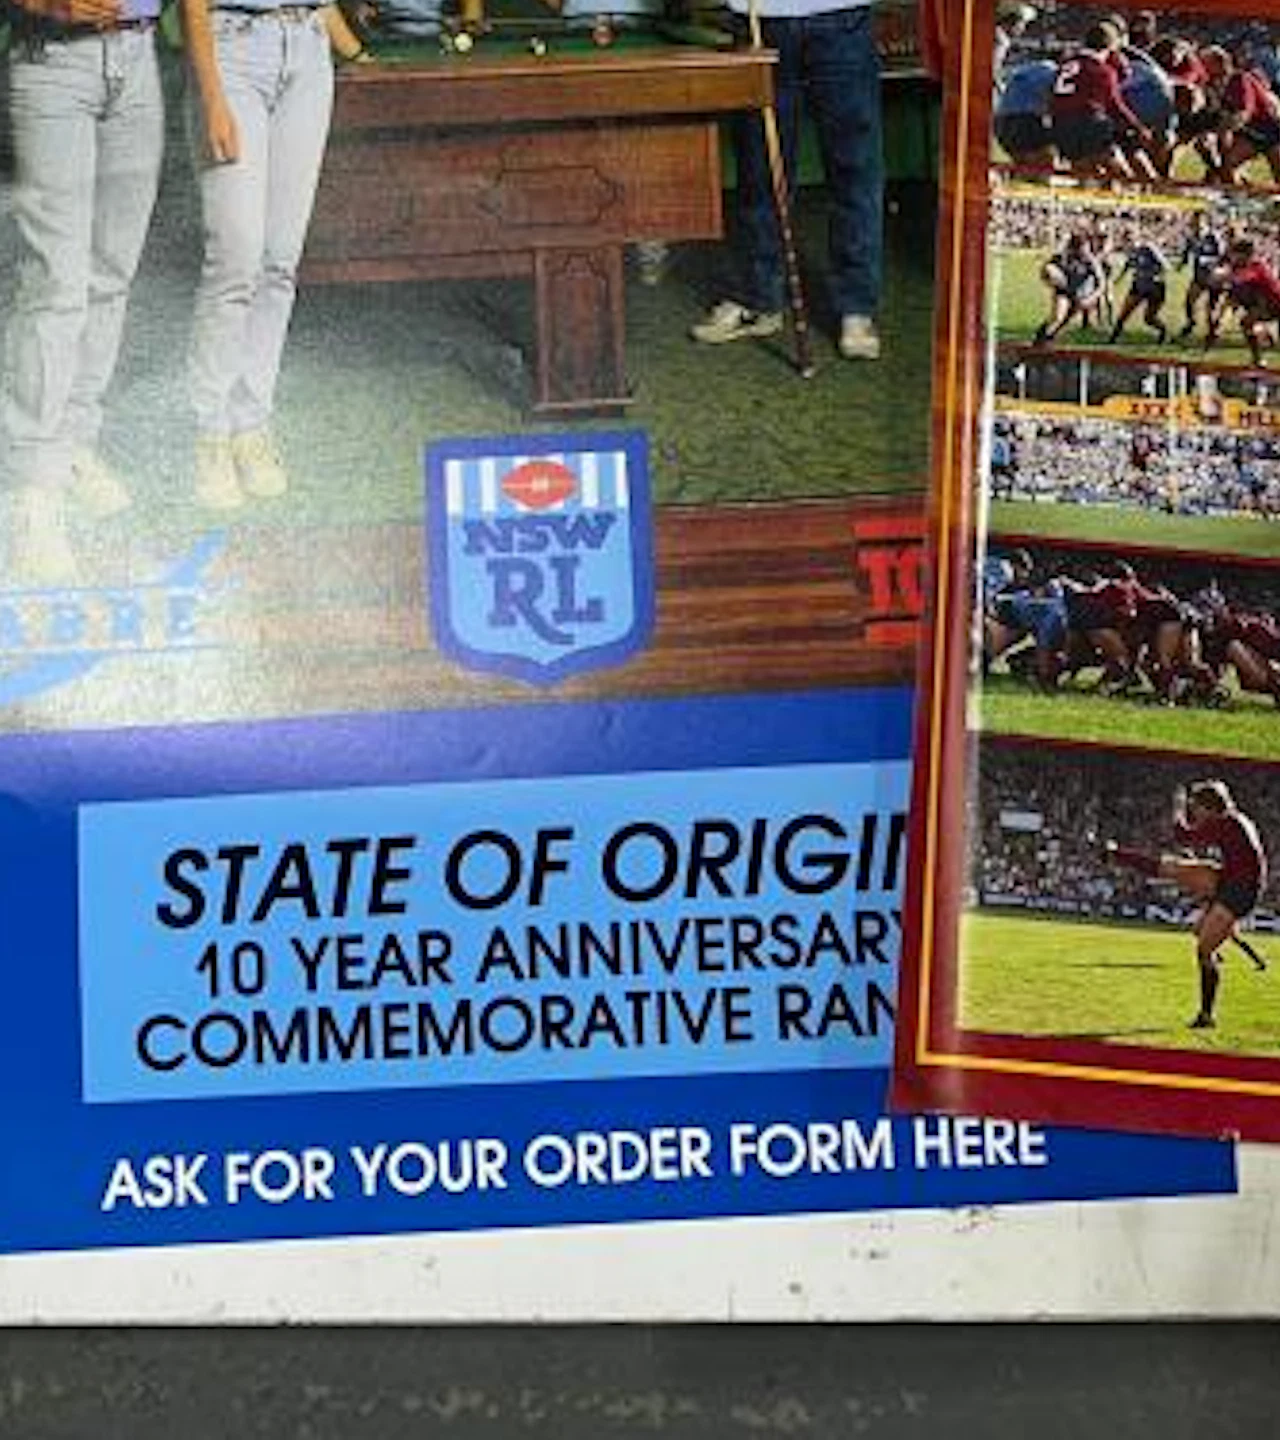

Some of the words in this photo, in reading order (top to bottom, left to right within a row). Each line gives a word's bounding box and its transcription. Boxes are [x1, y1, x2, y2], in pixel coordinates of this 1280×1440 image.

[462, 512, 617, 555] NSW
[485, 556, 606, 646] RL
[156, 832, 416, 928] STATE
[444, 824, 574, 912] OF
[200, 941, 267, 997] 10
[291, 930, 452, 991] YEAR
[138, 985, 752, 1071] COMMEMORATIVE
[103, 1154, 206, 1212] ASK
[229, 1143, 335, 1204] FOR
[351, 1136, 506, 1195] YOUR
[524, 1125, 713, 1188] ORDER
[731, 1118, 894, 1177] FORM
[914, 1117, 1048, 1168] HERE
